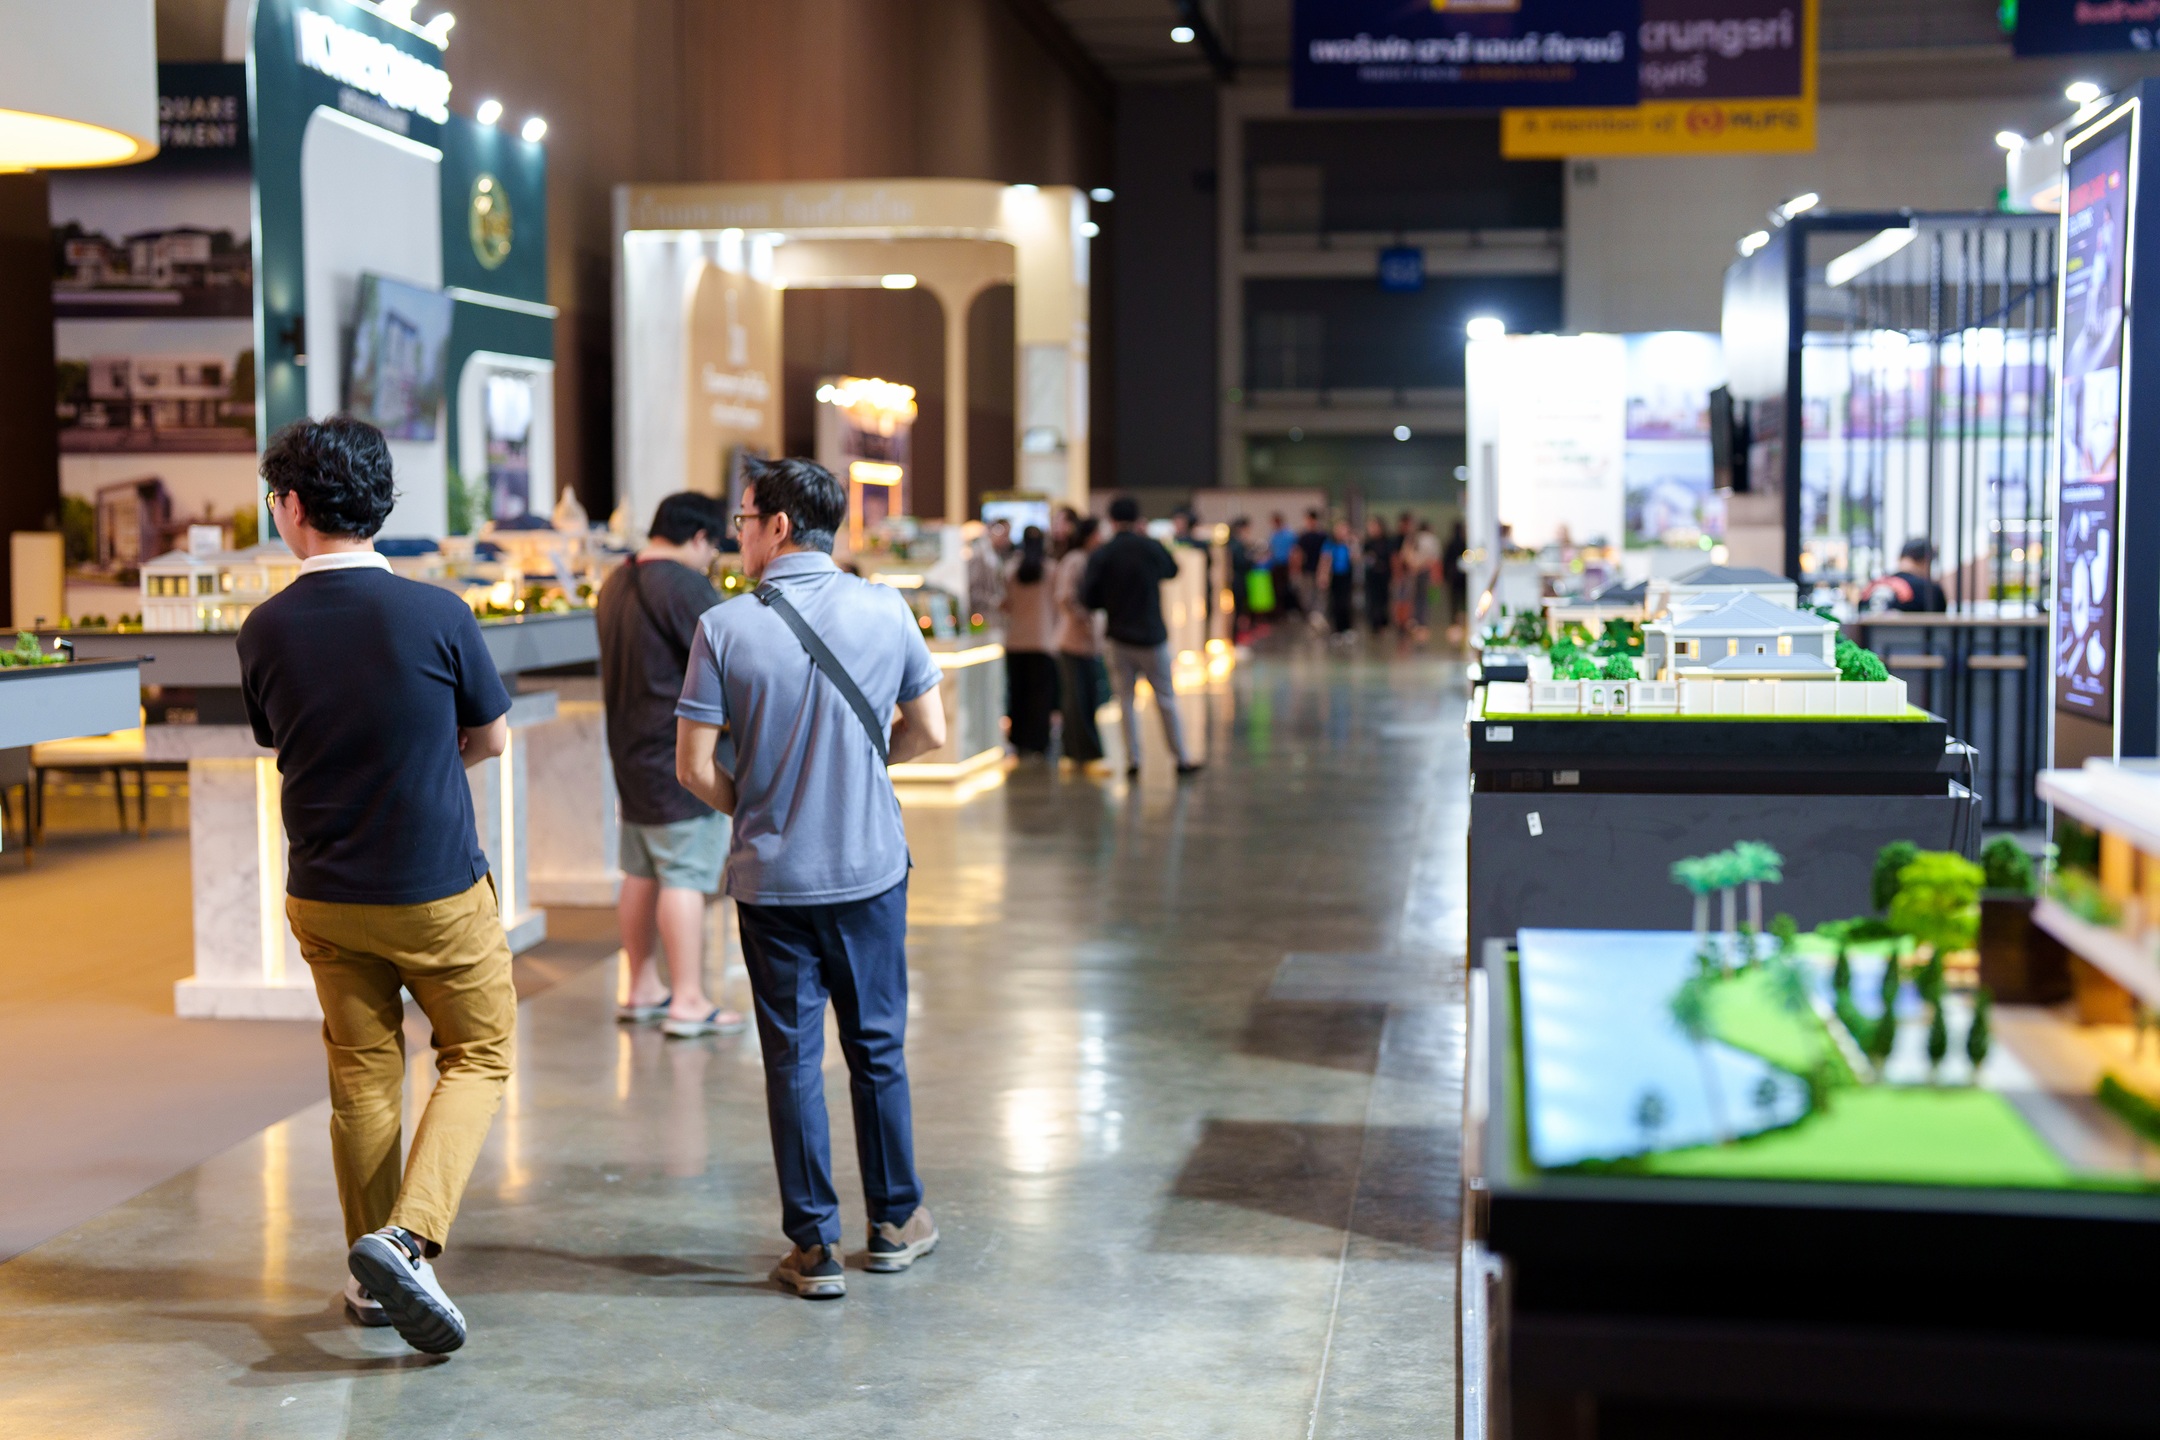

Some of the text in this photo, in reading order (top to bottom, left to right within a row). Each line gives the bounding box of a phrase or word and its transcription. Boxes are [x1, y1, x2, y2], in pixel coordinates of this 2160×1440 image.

[1522, 108, 1801, 134] A member of MUFG
